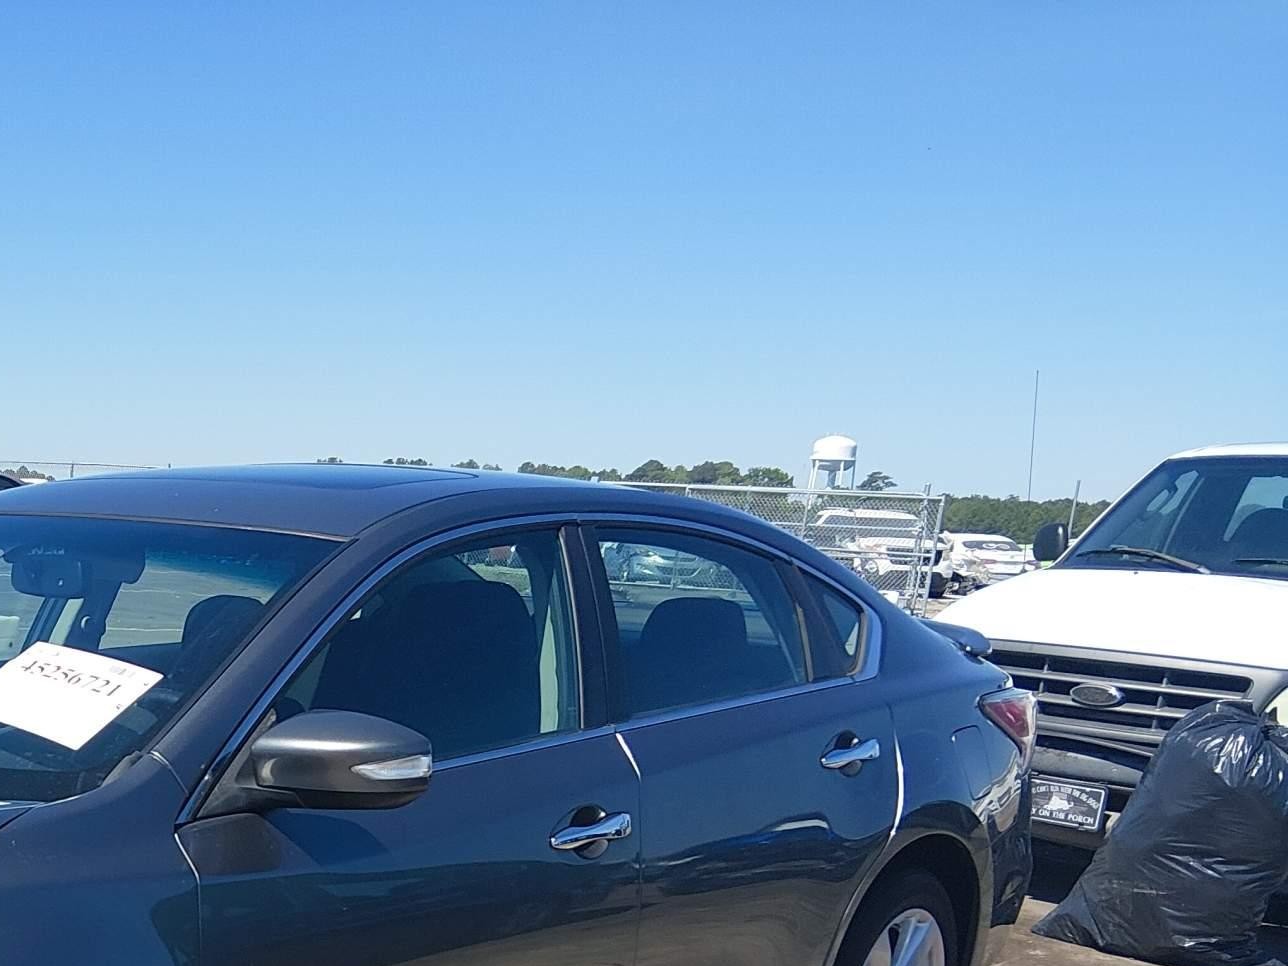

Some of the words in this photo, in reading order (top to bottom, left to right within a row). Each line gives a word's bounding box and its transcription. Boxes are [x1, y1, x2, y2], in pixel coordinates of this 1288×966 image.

[20, 659, 122, 697] 45256721
[1052, 811, 1065, 820] THE
[1068, 814, 1094, 824] PORCH
